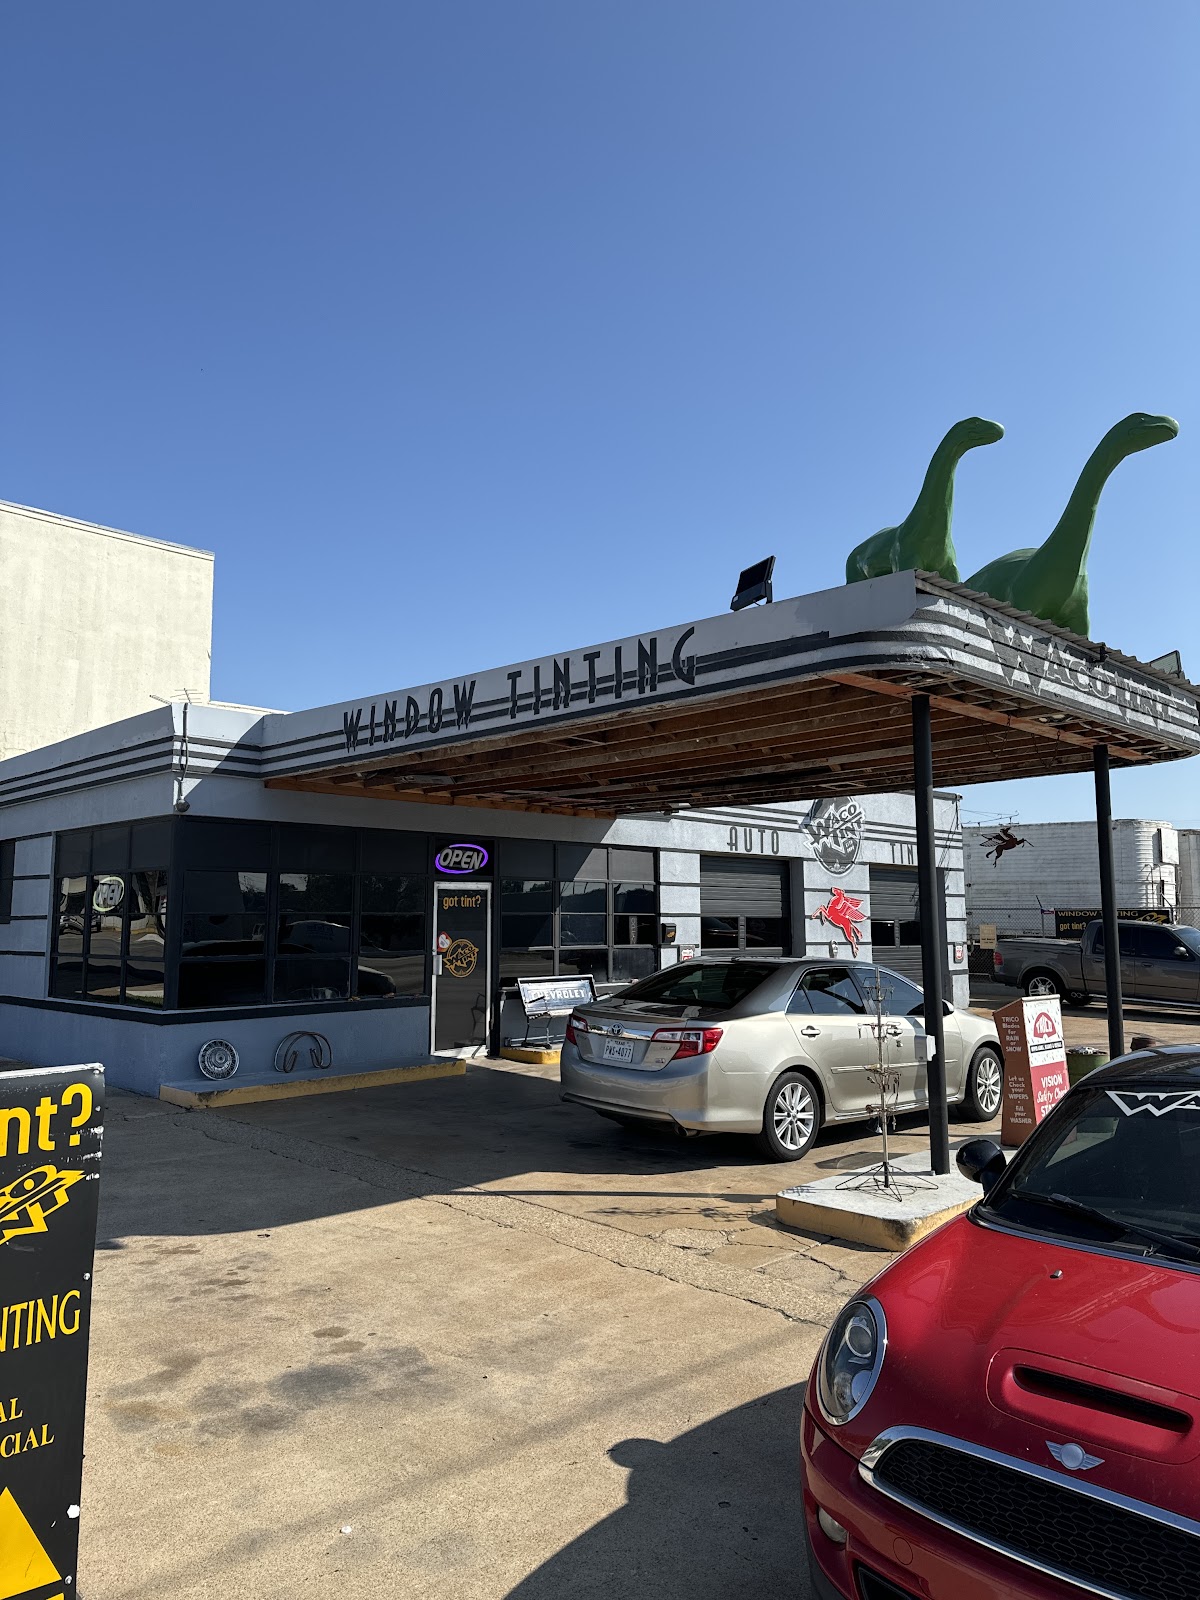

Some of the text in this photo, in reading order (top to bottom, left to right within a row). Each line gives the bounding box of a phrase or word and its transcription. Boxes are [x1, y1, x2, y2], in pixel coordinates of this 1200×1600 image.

[343, 626, 695, 753] WINDOW TINTING
[726, 826, 914, 864] AUTO TIN
[439, 848, 483, 870] OPEN
[443, 895, 481, 910] got tint?
[1060, 922, 1086, 931] got tint?
[530, 989, 585, 1001] CHEVROLET
[1036, 1014, 1053, 1034] TRICO
[1041, 1074, 1063, 1088] VISION
[1036, 1090, 1053, 1103] Safety
